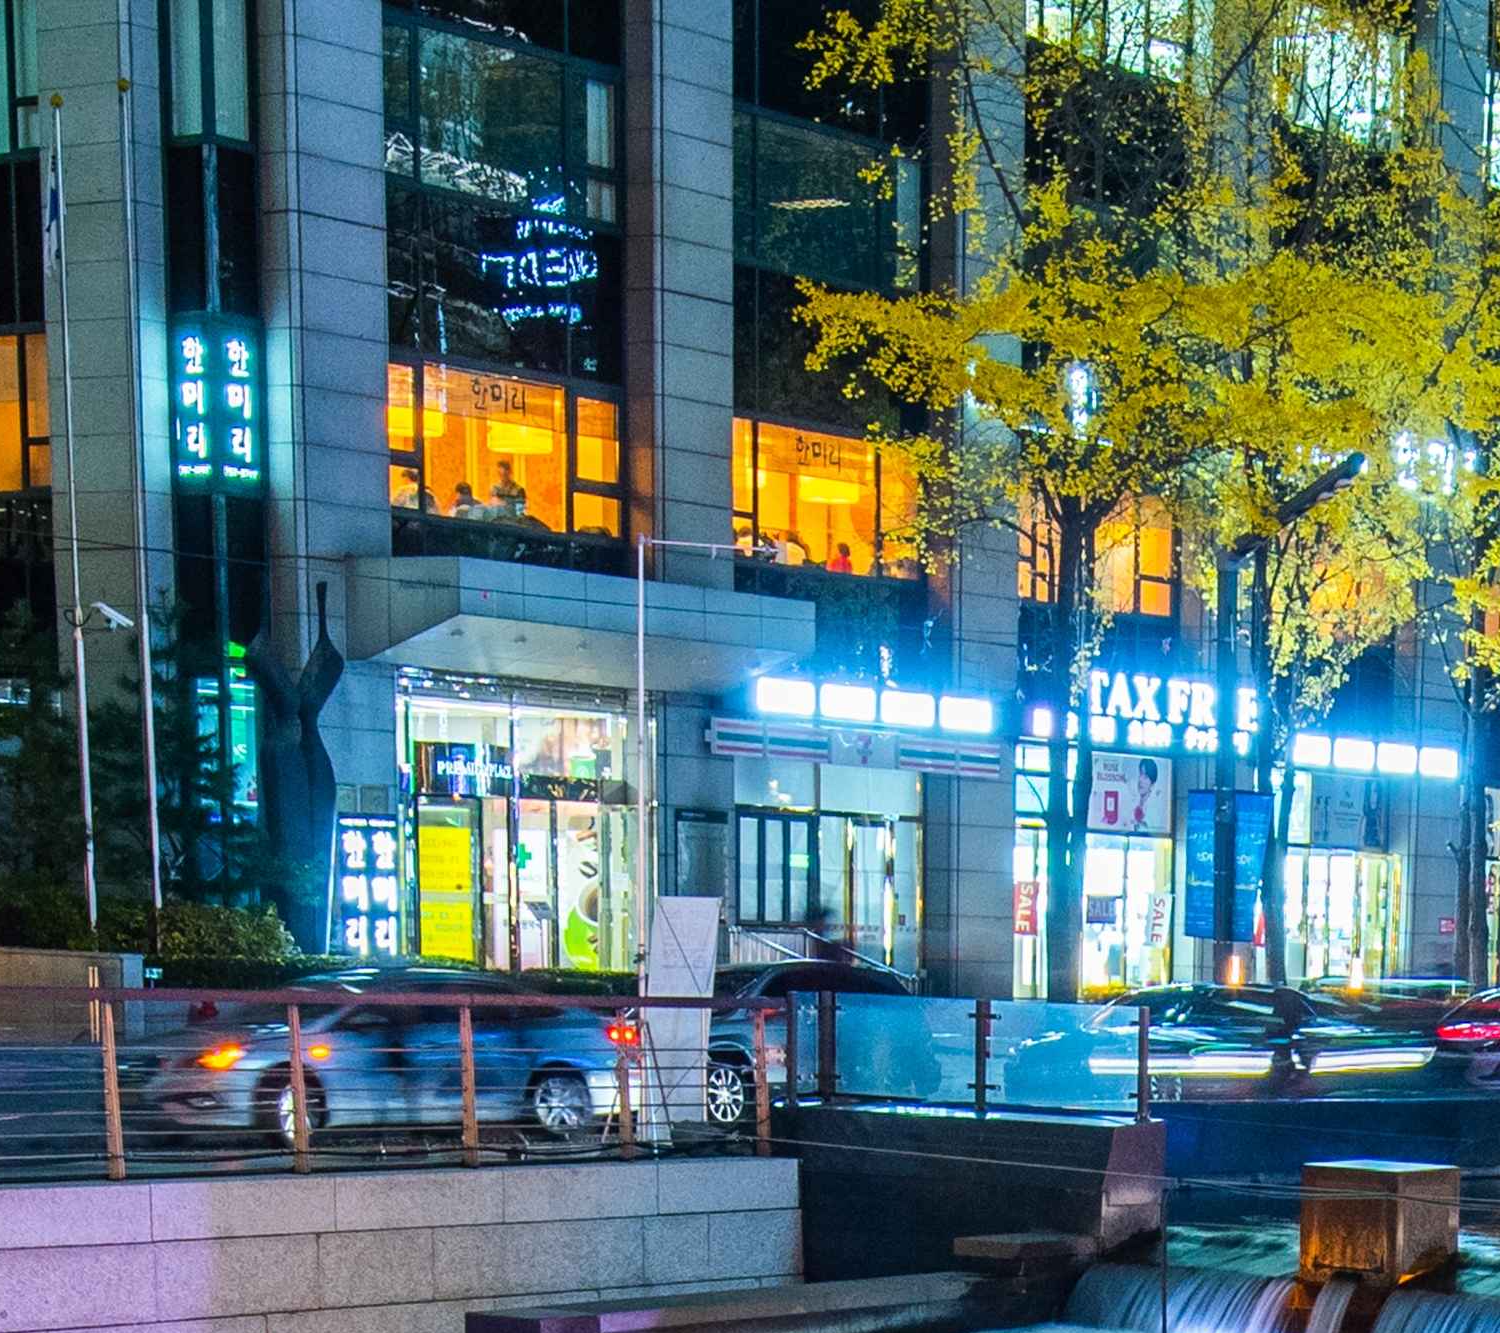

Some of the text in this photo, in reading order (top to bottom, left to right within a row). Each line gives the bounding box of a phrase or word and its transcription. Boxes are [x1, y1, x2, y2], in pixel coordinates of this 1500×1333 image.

[182, 336, 207, 459] 한미리
[227, 340, 252, 463] 한미리
[471, 378, 526, 417] 한미리
[796, 435, 841, 472] 한미리
[1090, 670, 1259, 732] TAX FRE
[1017, 882, 1035, 932] SALE
[1152, 898, 1166, 944] SALE
